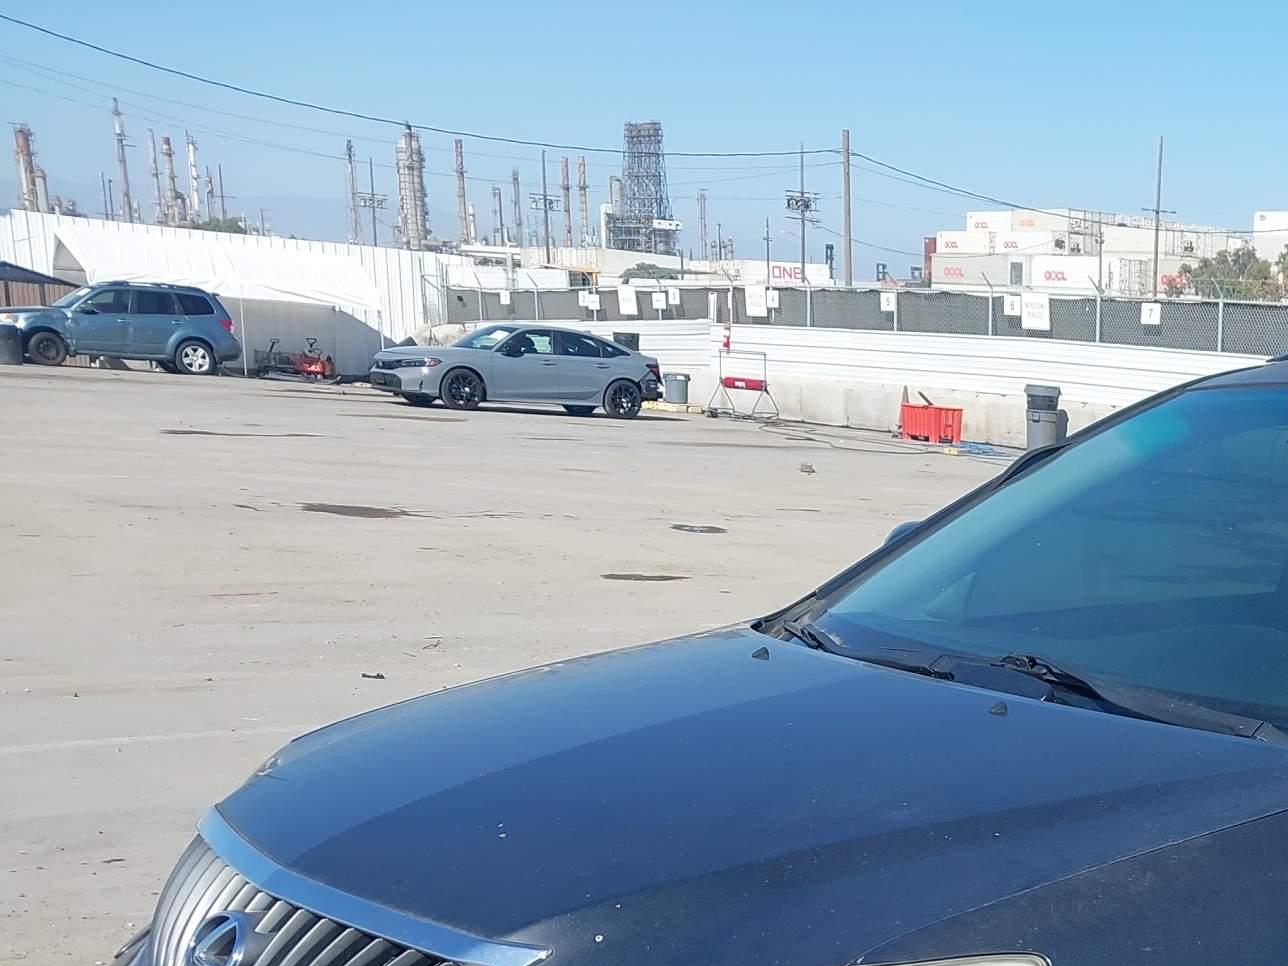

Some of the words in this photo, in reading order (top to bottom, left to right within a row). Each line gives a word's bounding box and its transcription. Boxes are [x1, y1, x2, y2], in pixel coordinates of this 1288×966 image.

[772, 265, 803, 280] ONE
[1044, 270, 1067, 281] OOCL
[1148, 308, 1153, 319] 7
